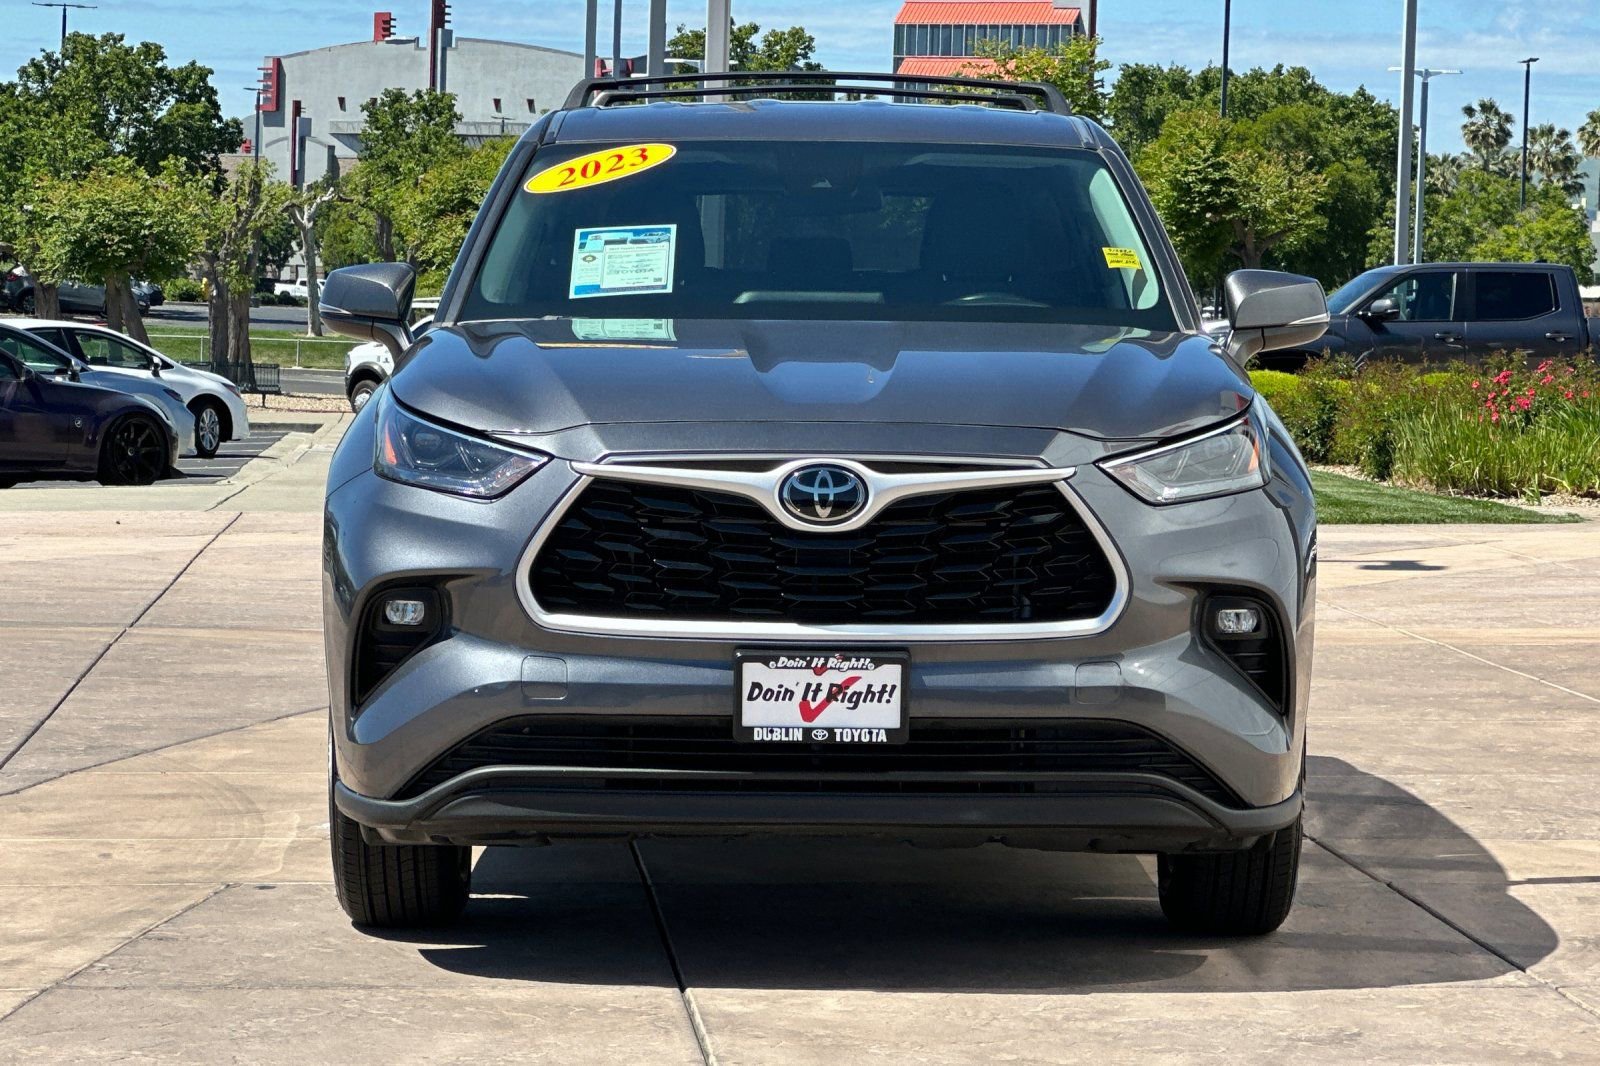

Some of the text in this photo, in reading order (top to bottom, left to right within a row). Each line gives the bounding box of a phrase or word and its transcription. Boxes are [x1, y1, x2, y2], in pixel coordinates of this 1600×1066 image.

[557, 147, 649, 187] 2023
[777, 656, 871, 672] Doin' It Right!
[747, 681, 897, 710] Doin' It Right!
[753, 727, 887, 742] DUBLIN TOYOTA
